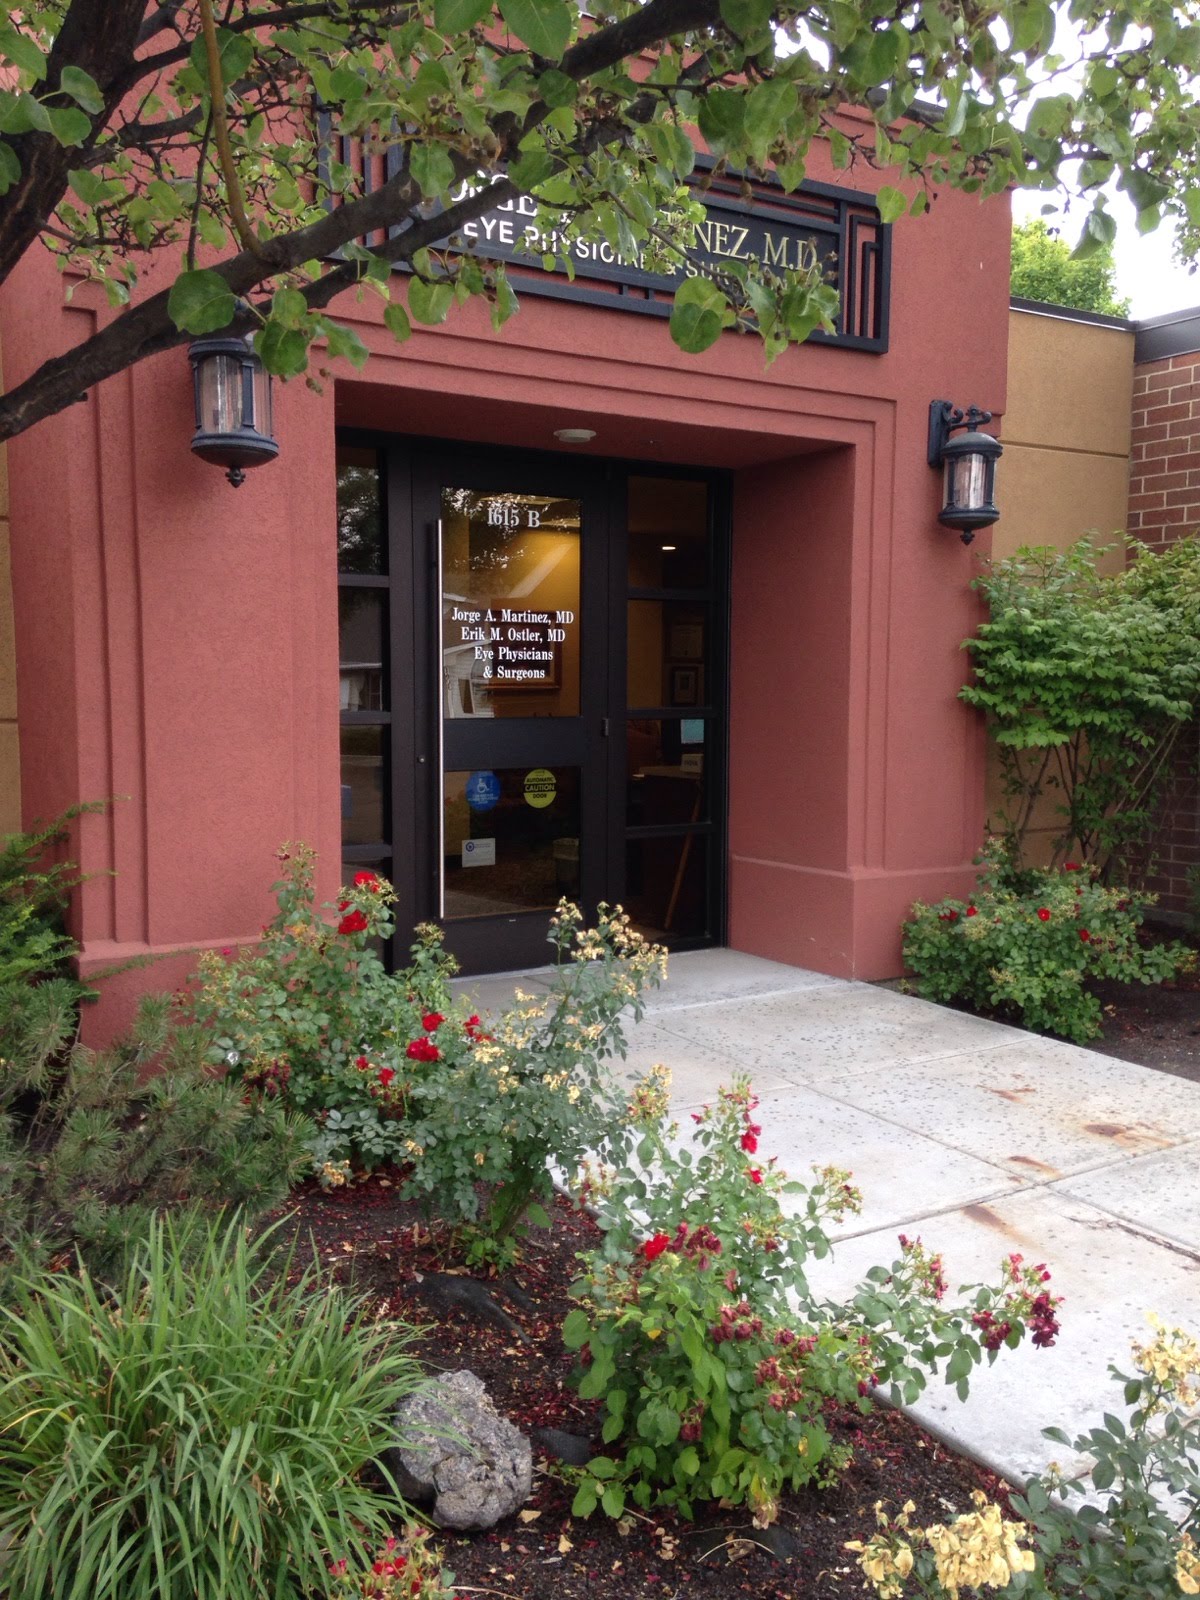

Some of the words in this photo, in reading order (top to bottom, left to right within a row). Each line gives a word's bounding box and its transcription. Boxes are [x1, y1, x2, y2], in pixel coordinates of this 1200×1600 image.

[463, 216, 514, 244] EYE
[487, 507, 520, 527] 1615
[528, 510, 541, 528] B
[452, 607, 481, 623] Jorge
[485, 609, 497, 622] A.
[501, 609, 552, 625] Martinez,
[556, 610, 574, 624] MD
[461, 626, 486, 641] Erik
[490, 628, 503, 641] M.
[508, 627, 543, 643] Ostler,
[547, 629, 566, 642] MD
[474, 646, 494, 662] Eye
[498, 646, 554, 663] Physicians
[483, 665, 493, 679] &
[497, 665, 545, 681] Surgeons
[525, 784, 555, 792] CAUTION
